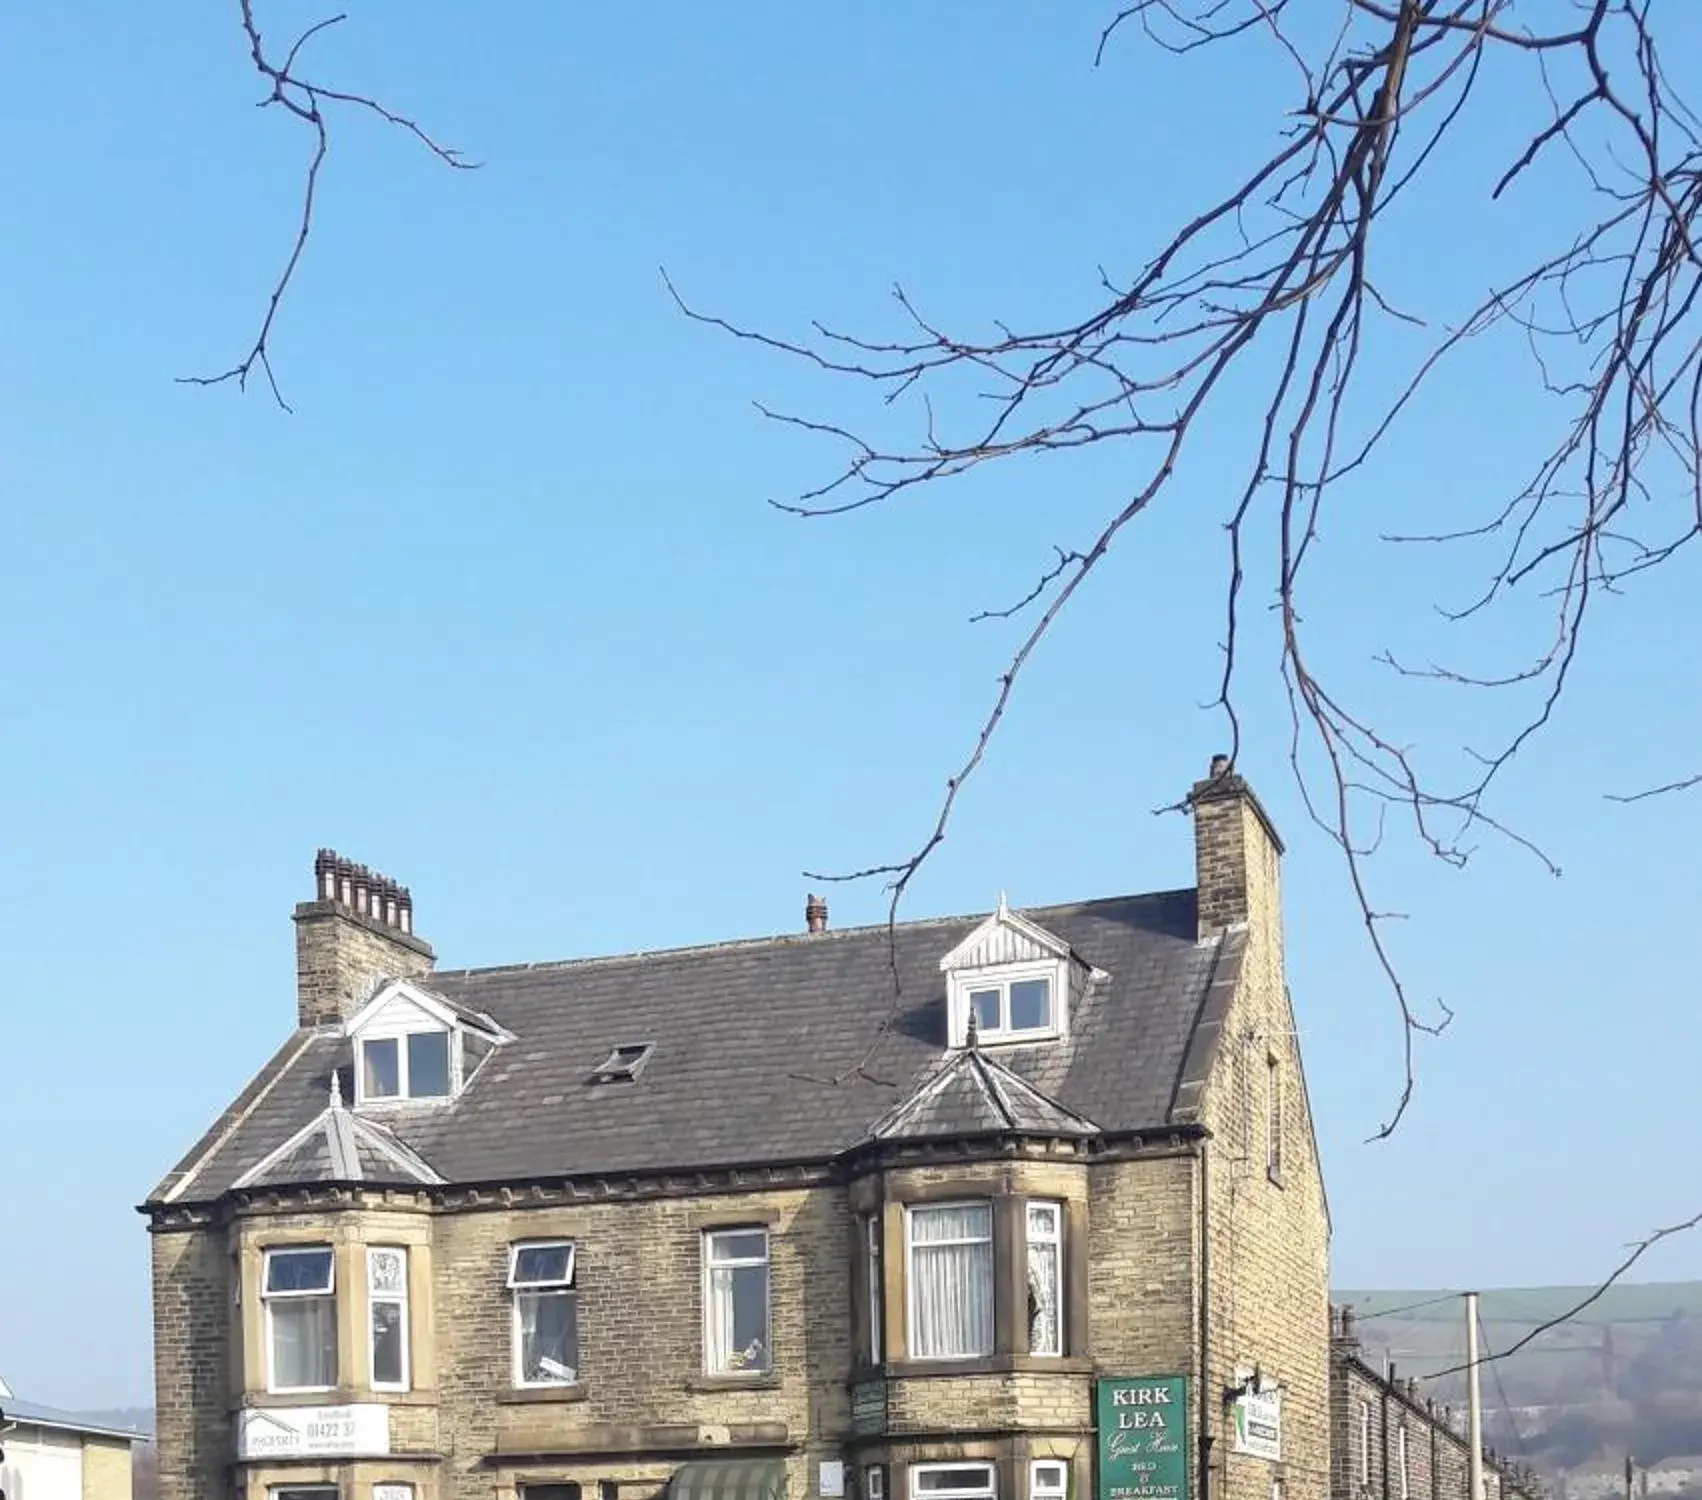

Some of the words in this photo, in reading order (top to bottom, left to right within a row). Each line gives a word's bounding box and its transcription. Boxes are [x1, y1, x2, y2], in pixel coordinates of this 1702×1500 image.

[1112, 1387, 1171, 1406] KIRK
[1119, 1411, 1166, 1429] LEA
[1110, 1485, 1178, 1497] BREAKFAST
